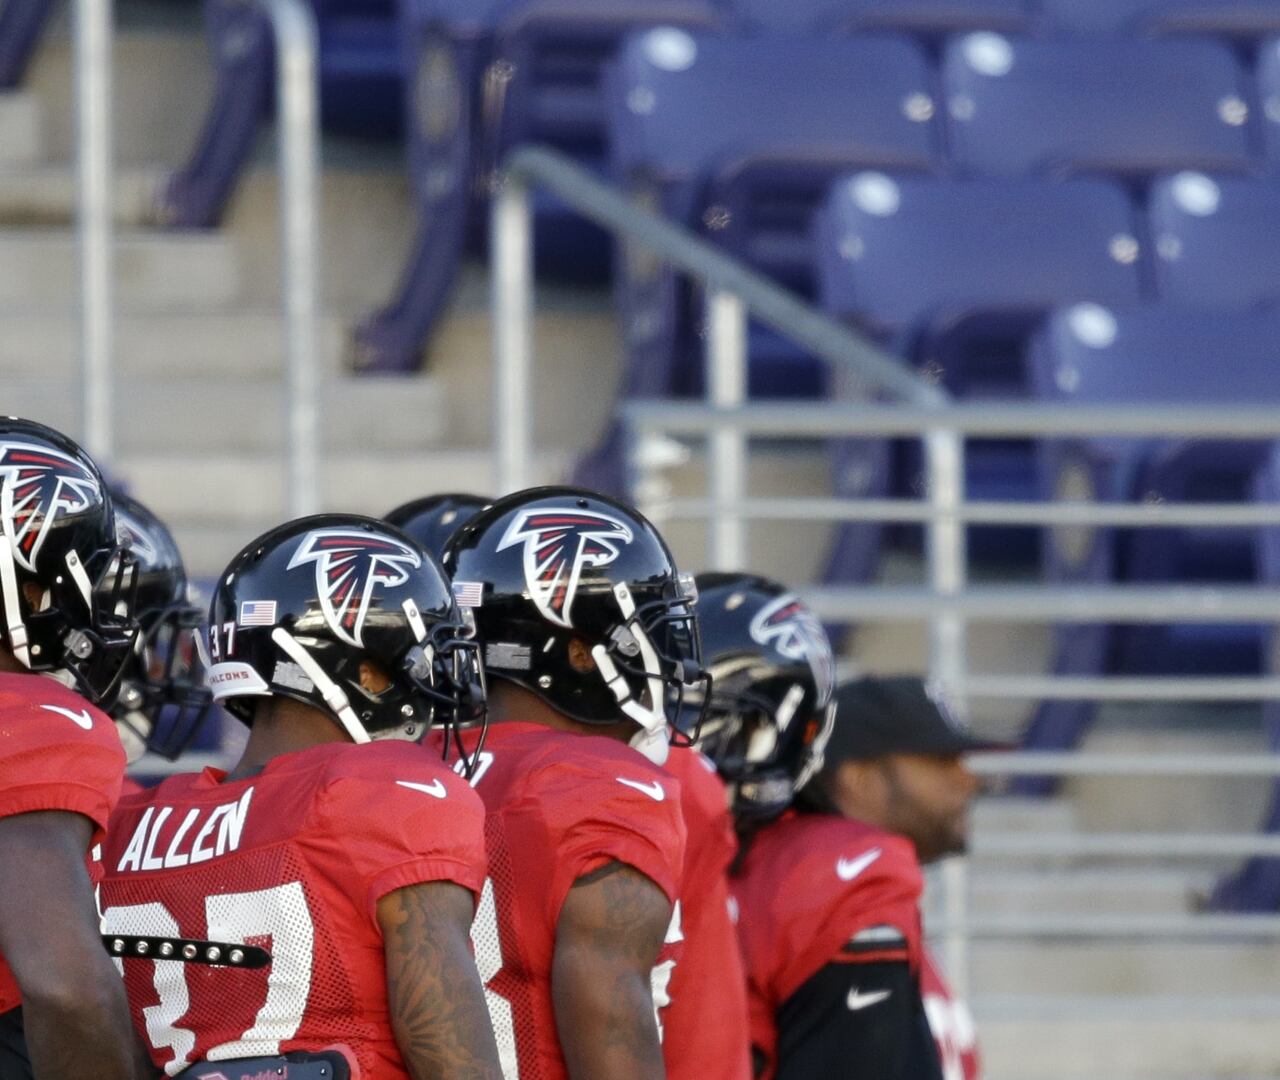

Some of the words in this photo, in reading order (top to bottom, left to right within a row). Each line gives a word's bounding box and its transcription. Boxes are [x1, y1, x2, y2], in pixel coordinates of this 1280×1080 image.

[210, 621, 238, 658] 37
[116, 785, 255, 872] ALLEN
[99, 881, 315, 1076] 37
